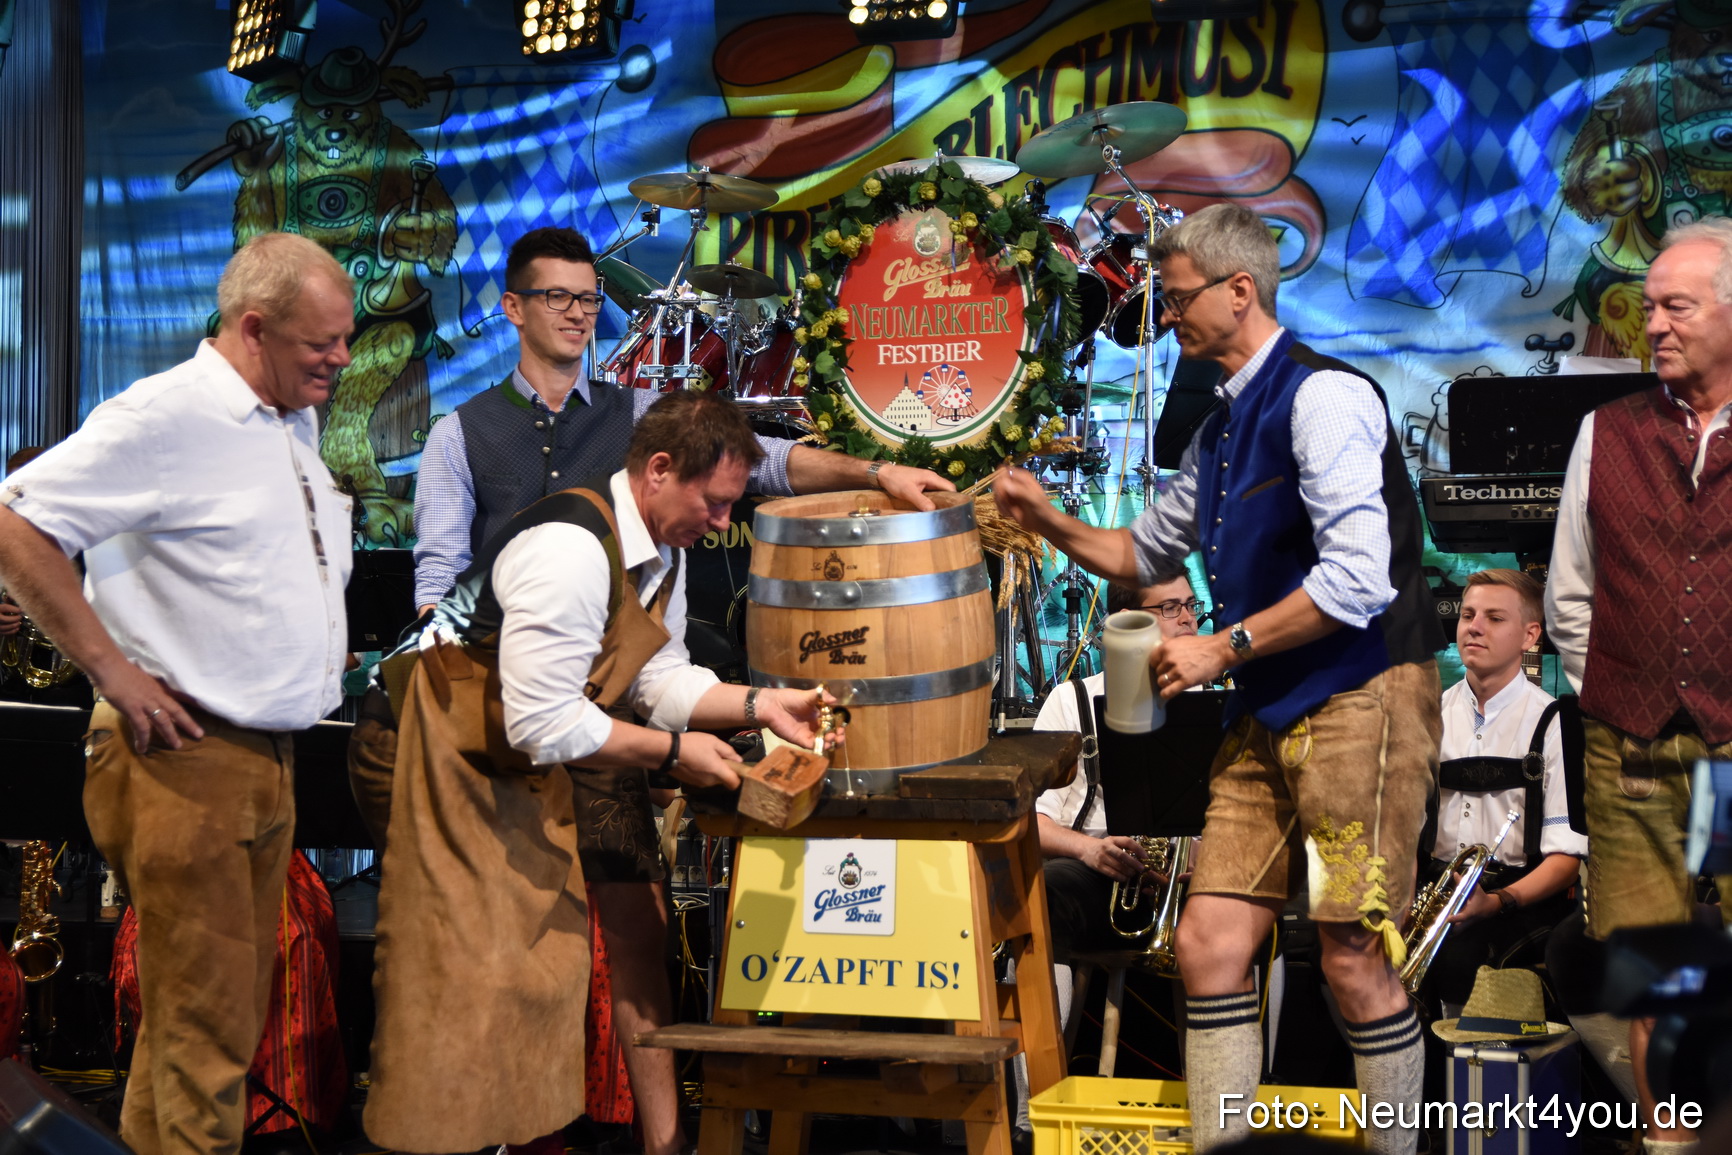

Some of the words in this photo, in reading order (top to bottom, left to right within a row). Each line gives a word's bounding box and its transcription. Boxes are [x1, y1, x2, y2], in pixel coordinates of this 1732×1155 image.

[923, 277, 972, 299] Bräu
[850, 297, 1011, 340] NEUMARKTER
[878, 340, 983, 365] FESTBIER
[1444, 484, 1562, 500] Technics
[799, 626, 870, 664] Glossner
[829, 648, 867, 665] Bräu
[813, 884, 886, 922] Glossner
[845, 906, 882, 923] Bräu
[915, 961, 960, 989] IS!
